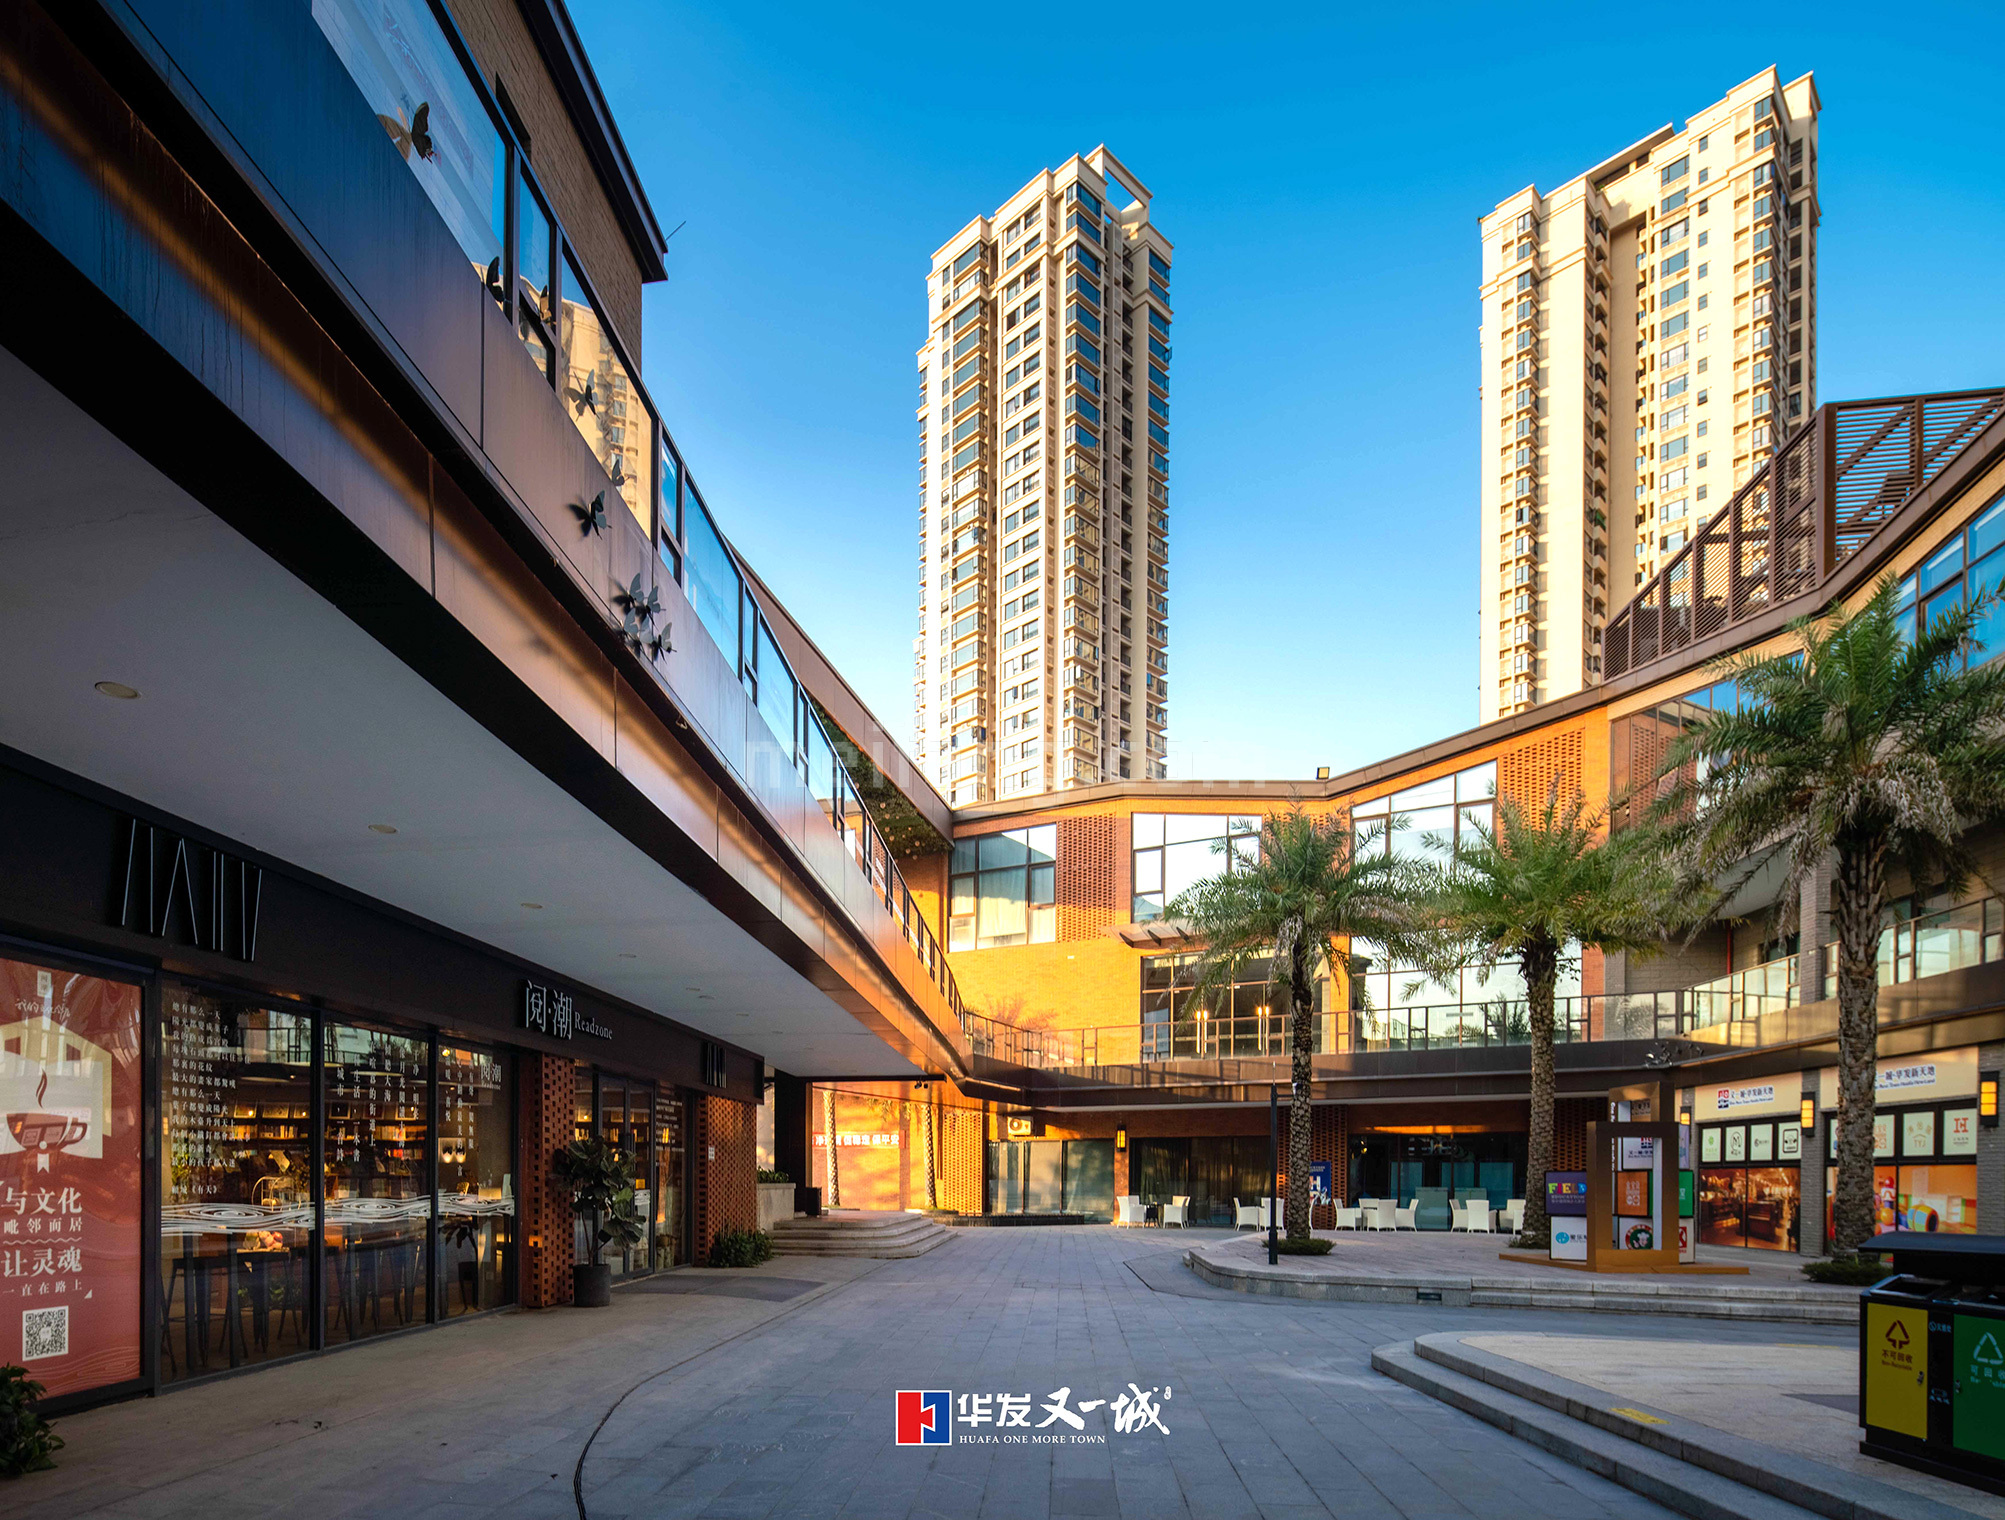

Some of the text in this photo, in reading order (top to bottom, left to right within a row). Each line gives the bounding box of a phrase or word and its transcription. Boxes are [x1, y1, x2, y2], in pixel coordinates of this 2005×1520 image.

[574, 1011, 613, 1040] Readzone
[872, 1133, 900, 1145] 保平安
[1548, 1182, 1588, 1195] FIELD
[0, 1187, 83, 1216] 与文化
[0, 1246, 83, 1278] 让灵魂
[2, 1279, 83, 1297] 一直在路上
[1881, 1349, 1913, 1364] 不可回收
